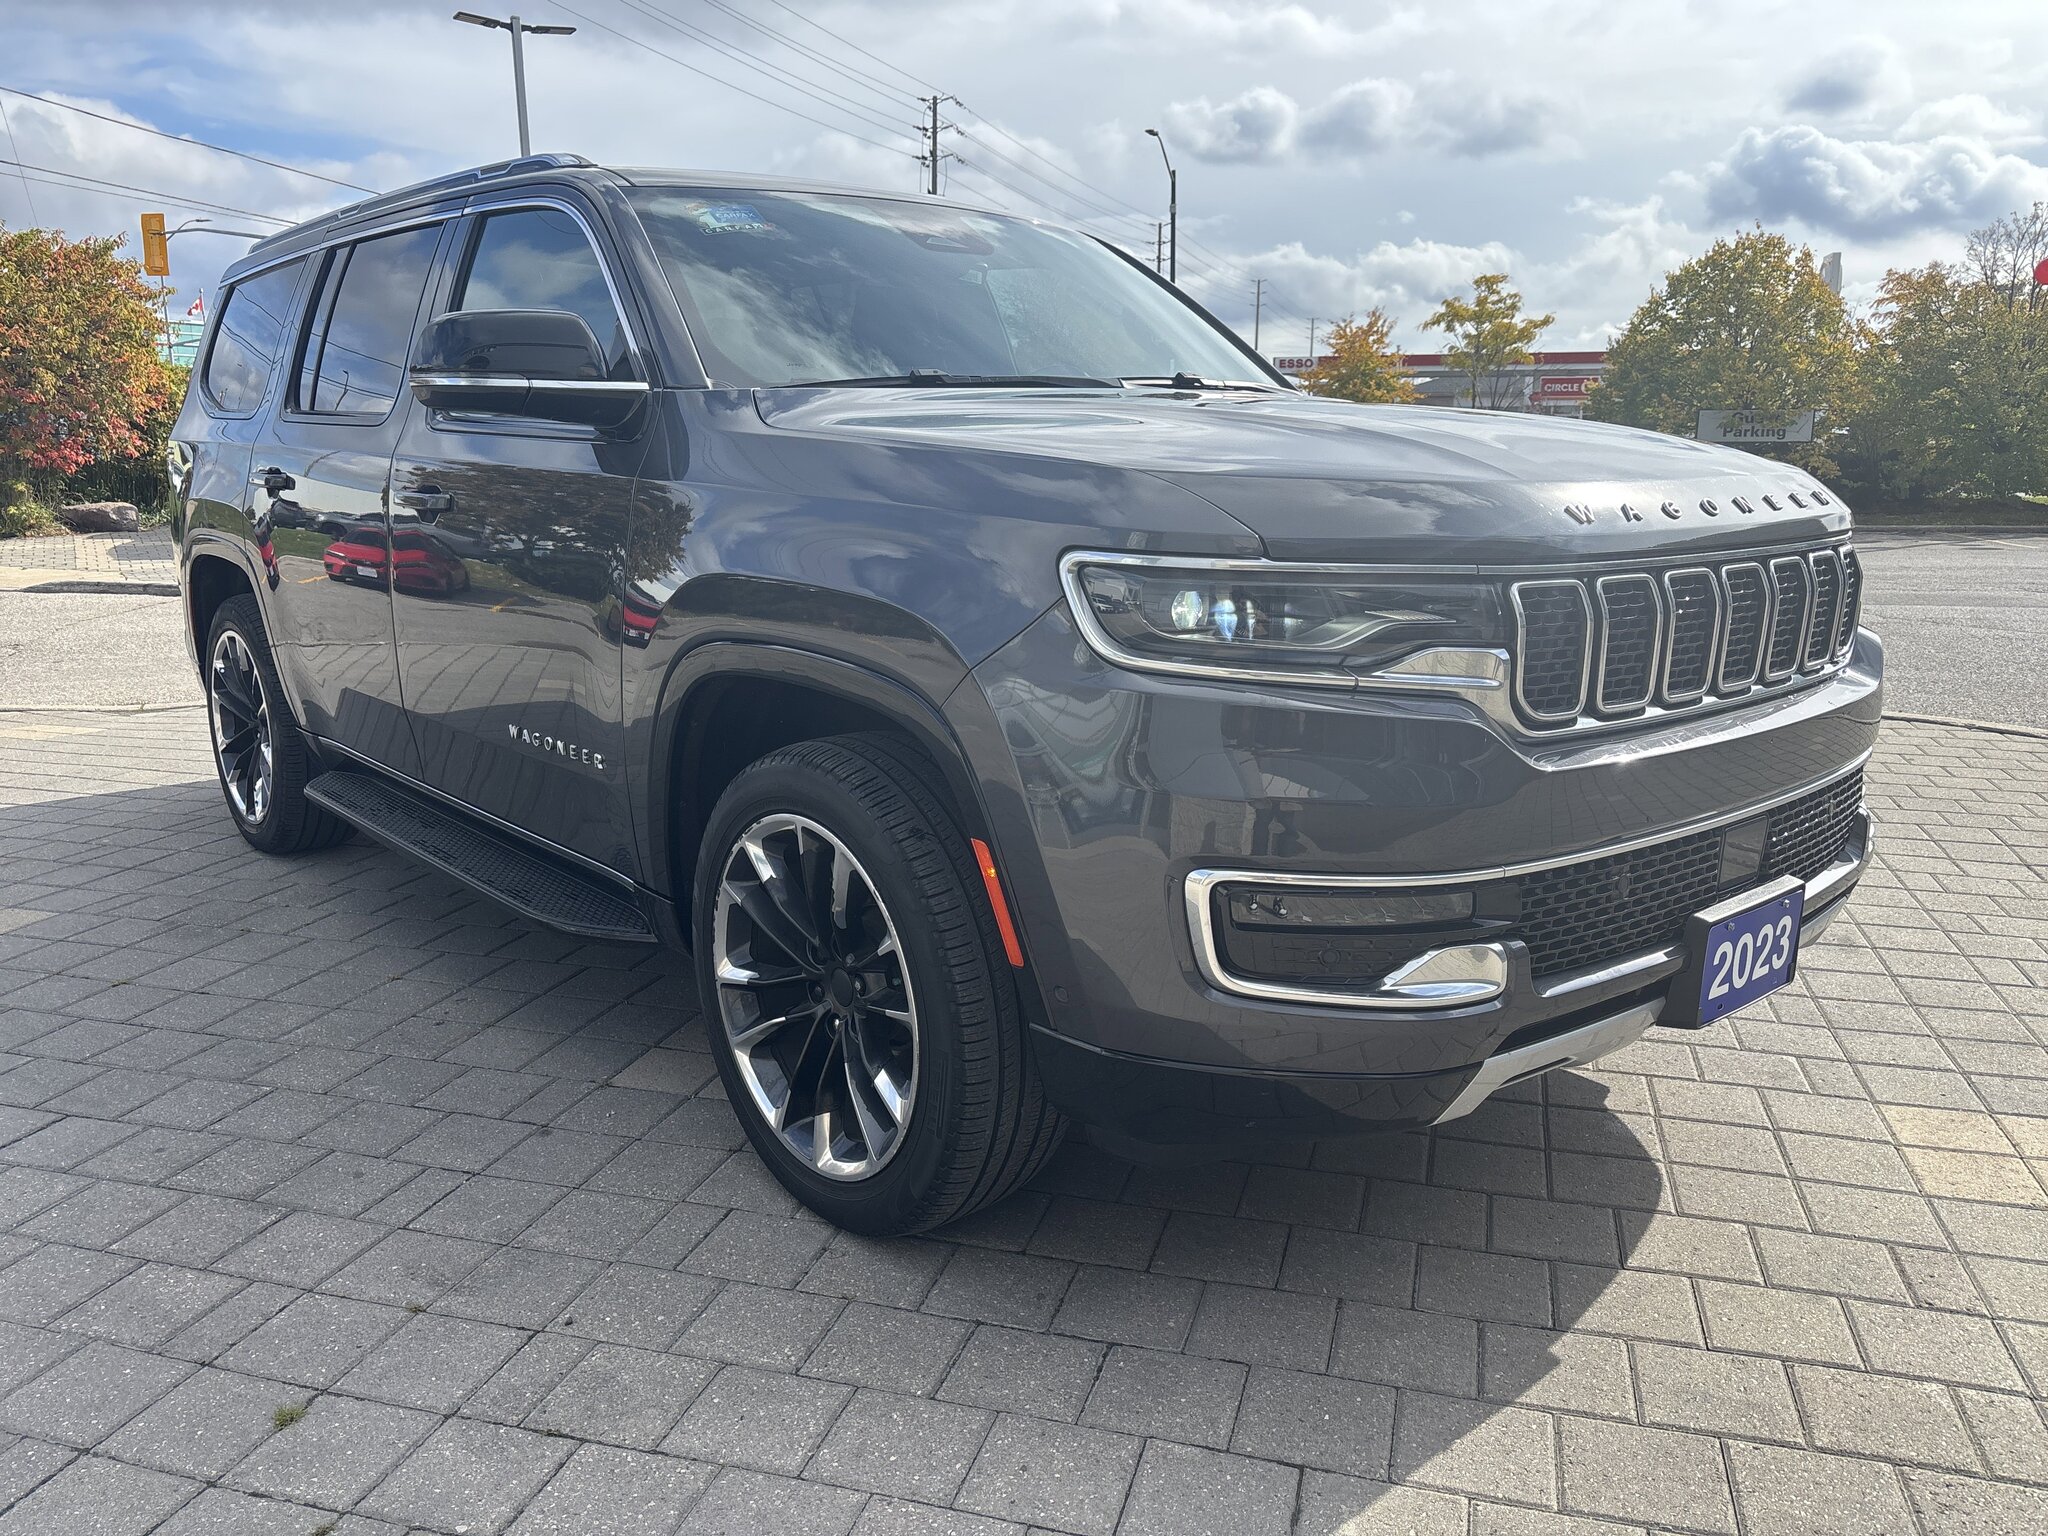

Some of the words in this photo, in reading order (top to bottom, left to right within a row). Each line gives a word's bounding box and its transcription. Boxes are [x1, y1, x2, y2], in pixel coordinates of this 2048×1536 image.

[1279, 358, 1314, 369] ESSO
[1544, 383, 1580, 392] CIRCLE
[1722, 425, 1787, 440] Parking
[1563, 490, 1831, 525] WAGONEER
[508, 723, 604, 769] WAGONEER
[1708, 915, 1793, 1001] 2023
